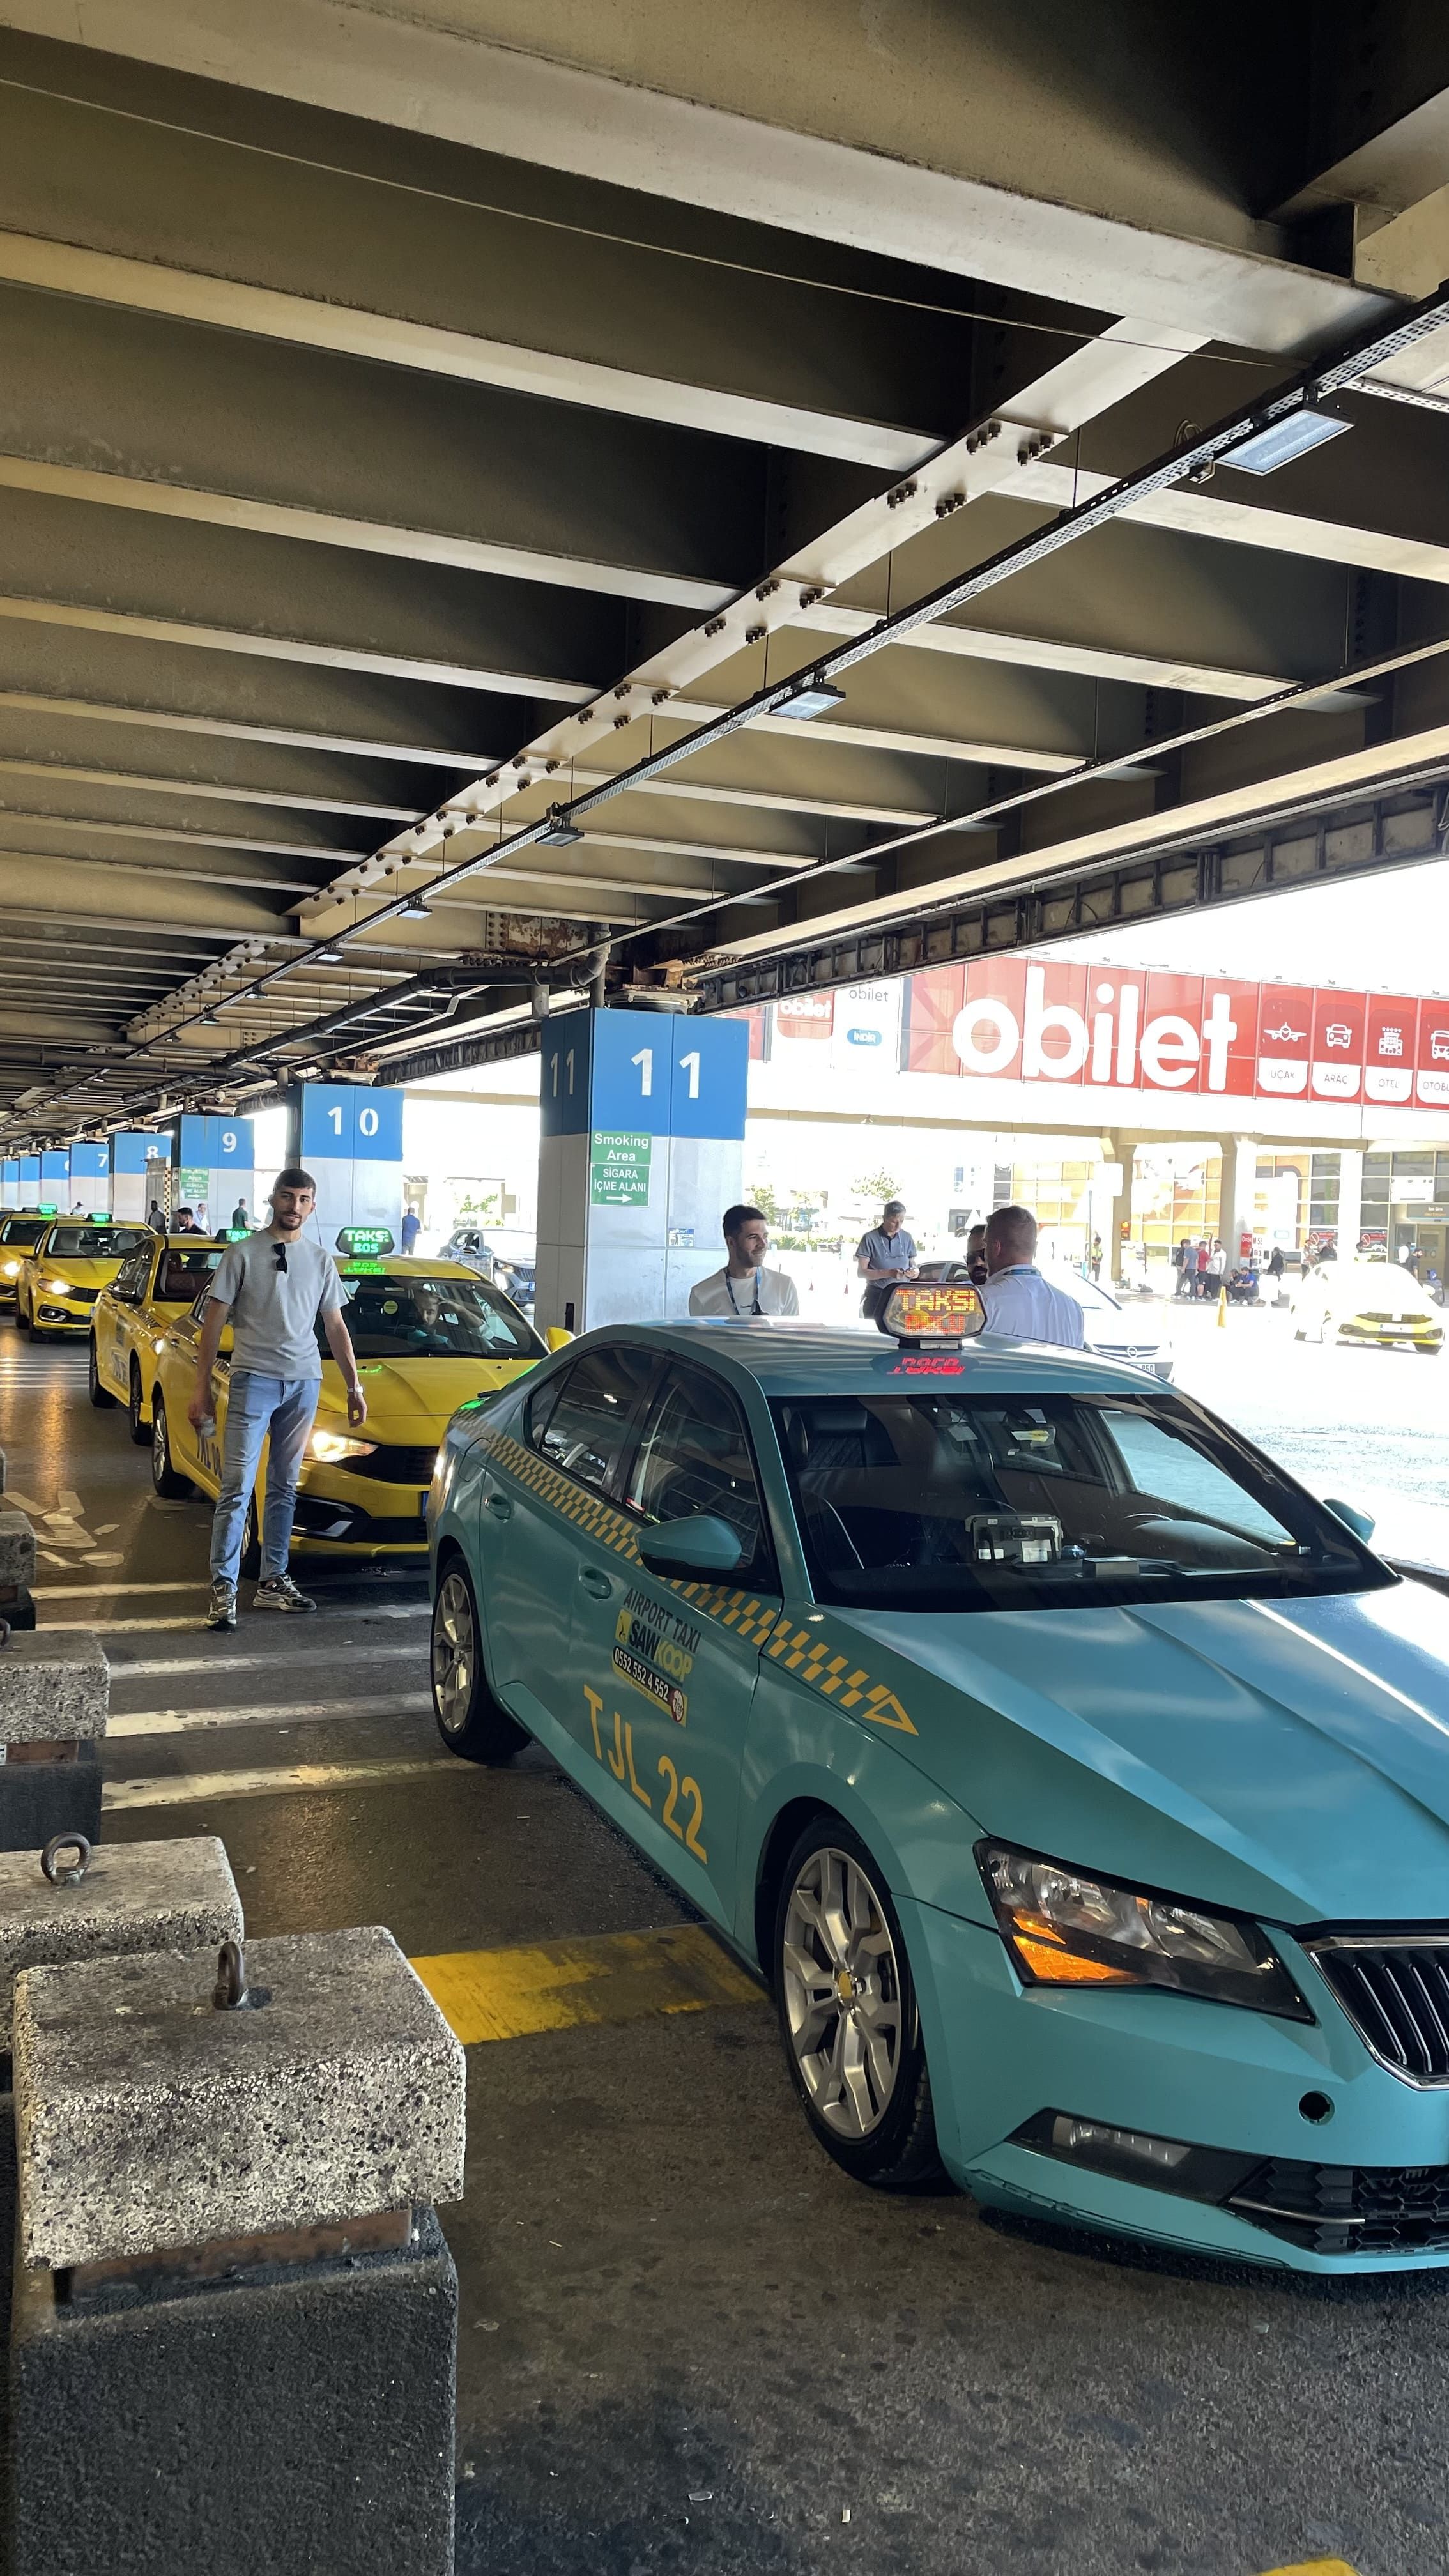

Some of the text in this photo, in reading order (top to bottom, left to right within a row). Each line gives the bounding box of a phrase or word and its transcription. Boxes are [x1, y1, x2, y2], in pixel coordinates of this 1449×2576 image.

[849, 986, 889, 1002] obilet
[780, 998, 832, 1018] obilet
[952, 966, 1238, 1091] obilet
[550, 1048, 575, 1098] 11
[631, 1048, 701, 1099] 11
[1270, 1069, 1294, 1081] UÇAK
[1378, 1078, 1399, 1089] OTEL
[327, 1106, 379, 1137] 10
[222, 1132, 237, 1153] 9
[594, 1133, 649, 1150] Smoking
[97, 1154, 108, 1167] 7
[146, 1145, 158, 1160] 8
[607, 1150, 636, 1162] Area
[602, 1167, 638, 1180] SİGARA
[594, 1179, 647, 1193] İÇME ALANI
[623, 1587, 702, 1653] AIRPORT TAXI
[629, 1620, 693, 1682] SAWKOOP
[614, 1647, 632, 1673] 0552
[632, 1661, 647, 1685] 552
[647, 1673, 654, 1690] 4
[654, 1678, 669, 1703] 552
[583, 1684, 708, 1864] TJL 22
